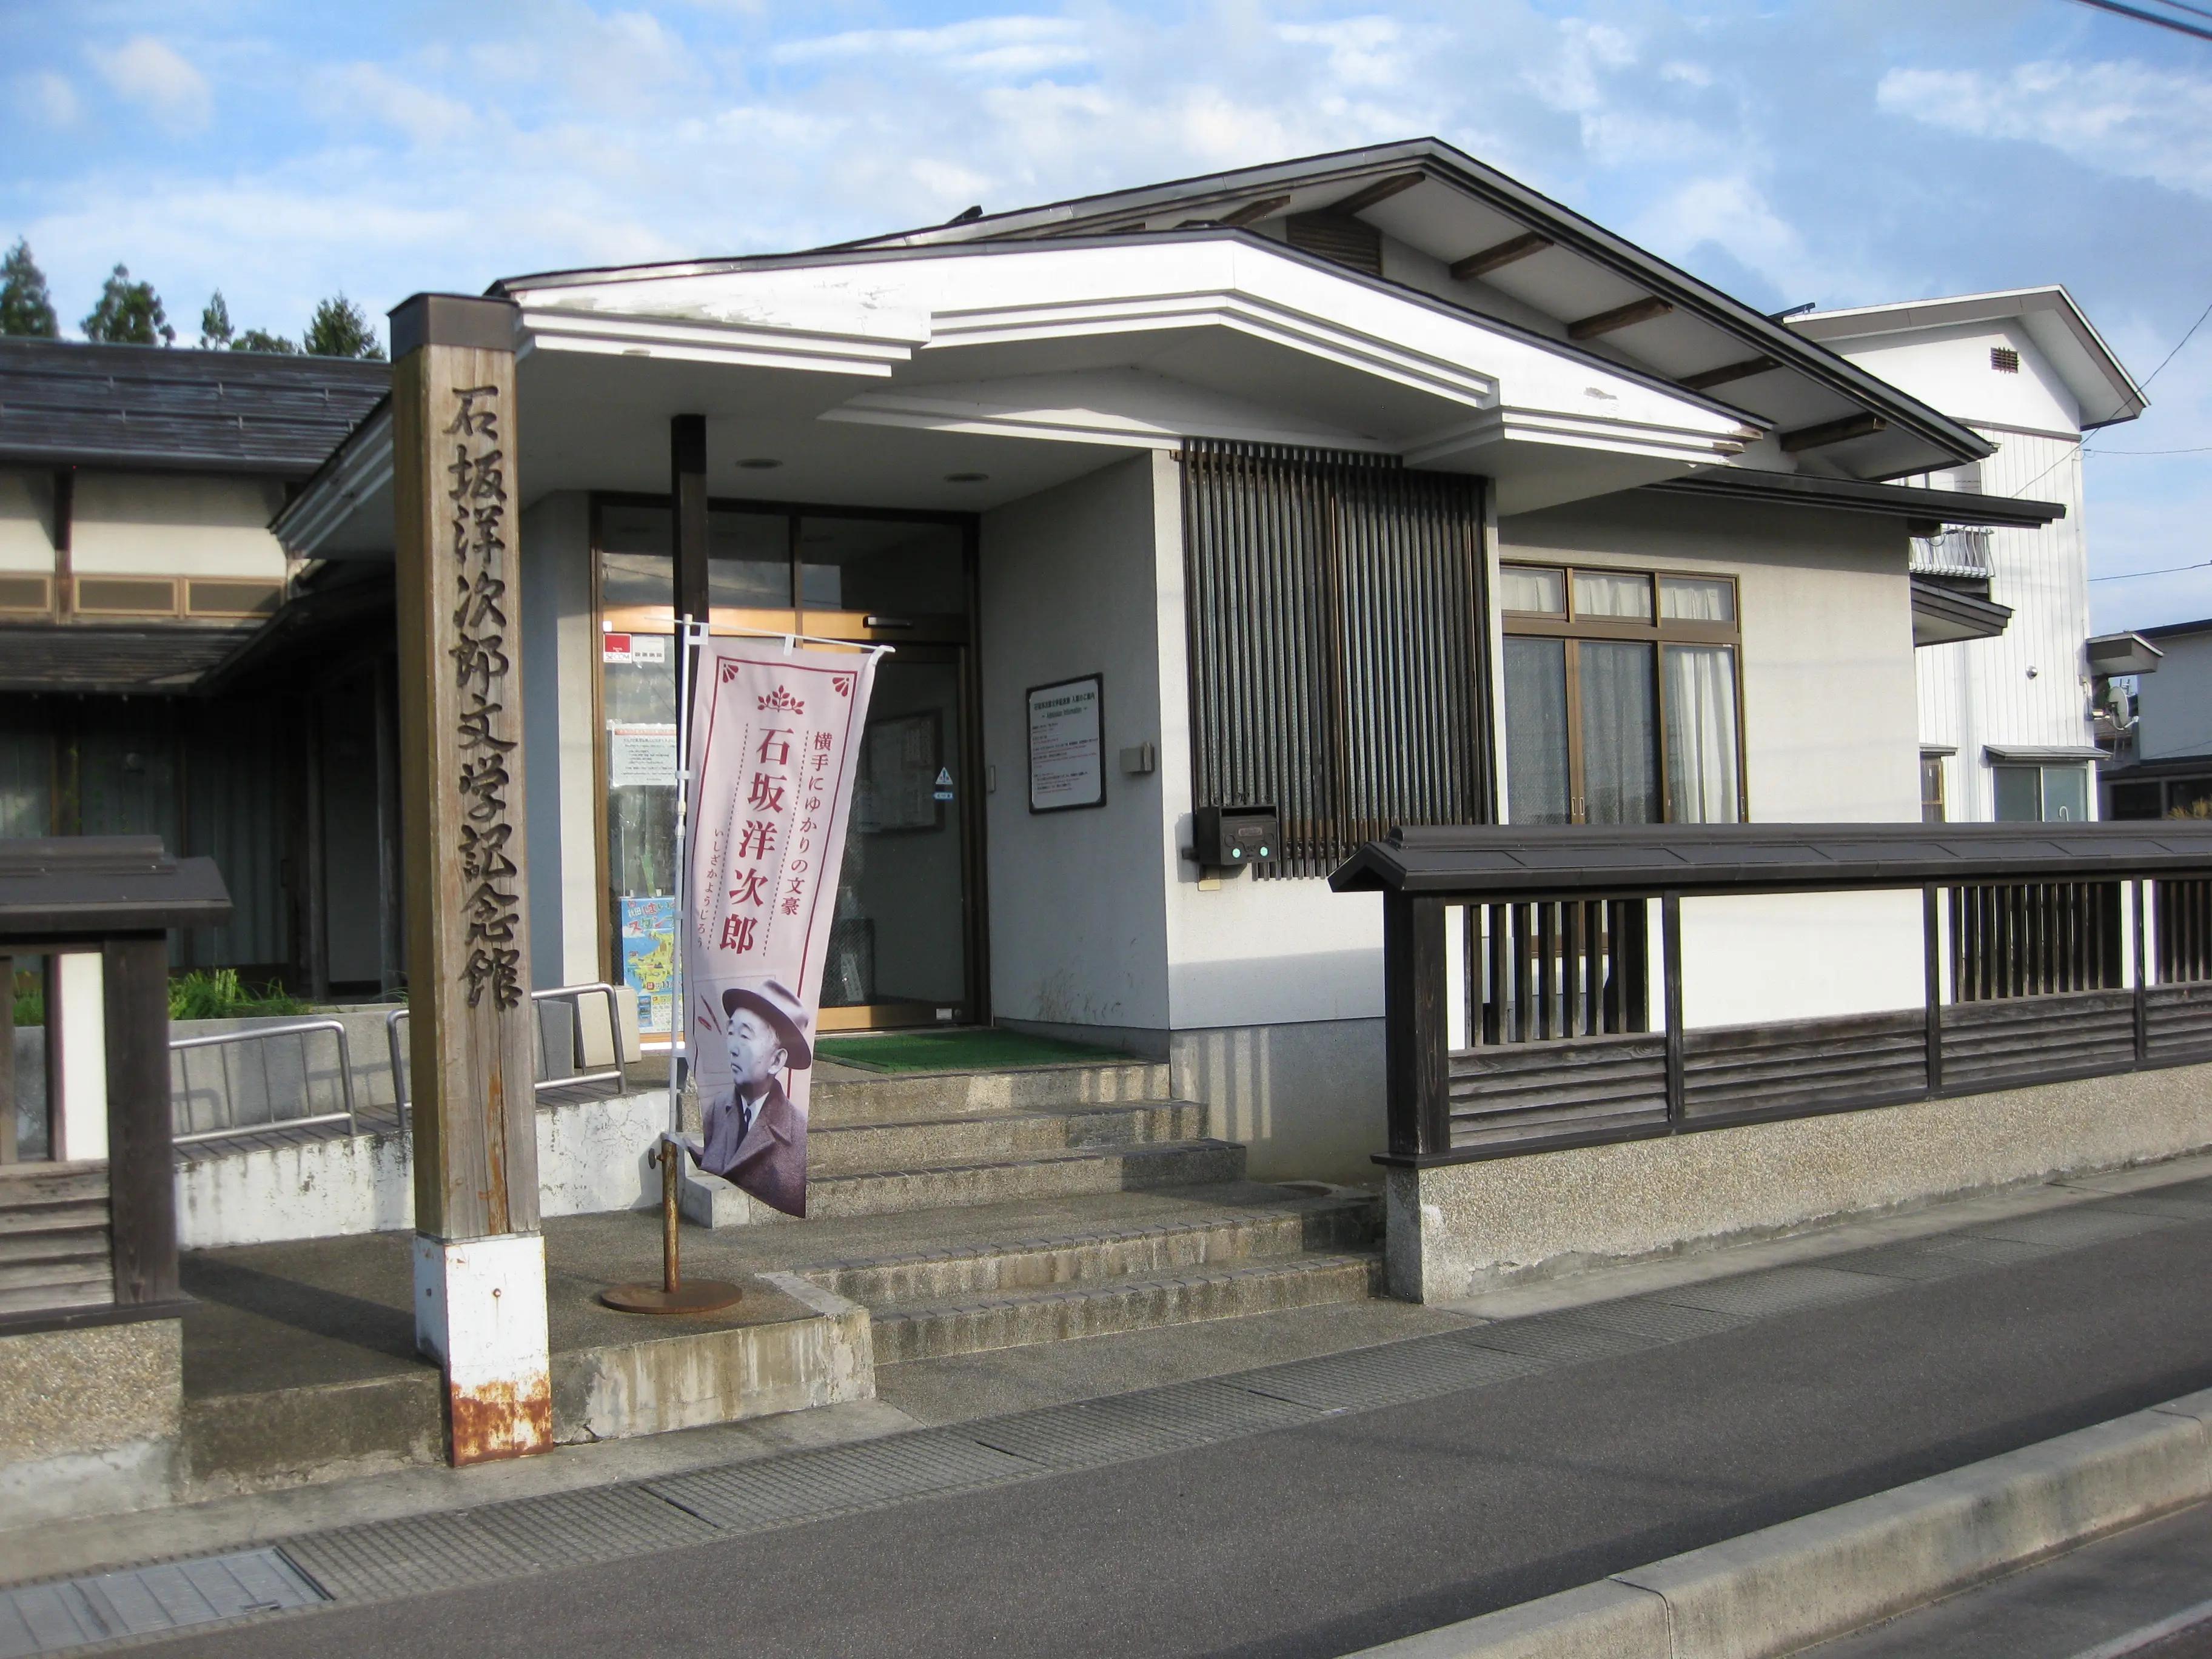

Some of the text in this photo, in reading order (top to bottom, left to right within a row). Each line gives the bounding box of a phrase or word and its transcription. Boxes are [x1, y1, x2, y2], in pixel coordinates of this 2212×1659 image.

[442, 385, 523, 1011] 石坂洋次郎文学記念館
[697, 828, 723, 948] いしざかようじろう
[719, 727, 794, 954] 石坂洋次郎
[780, 731, 833, 916] 横手にゆかりの文豪
